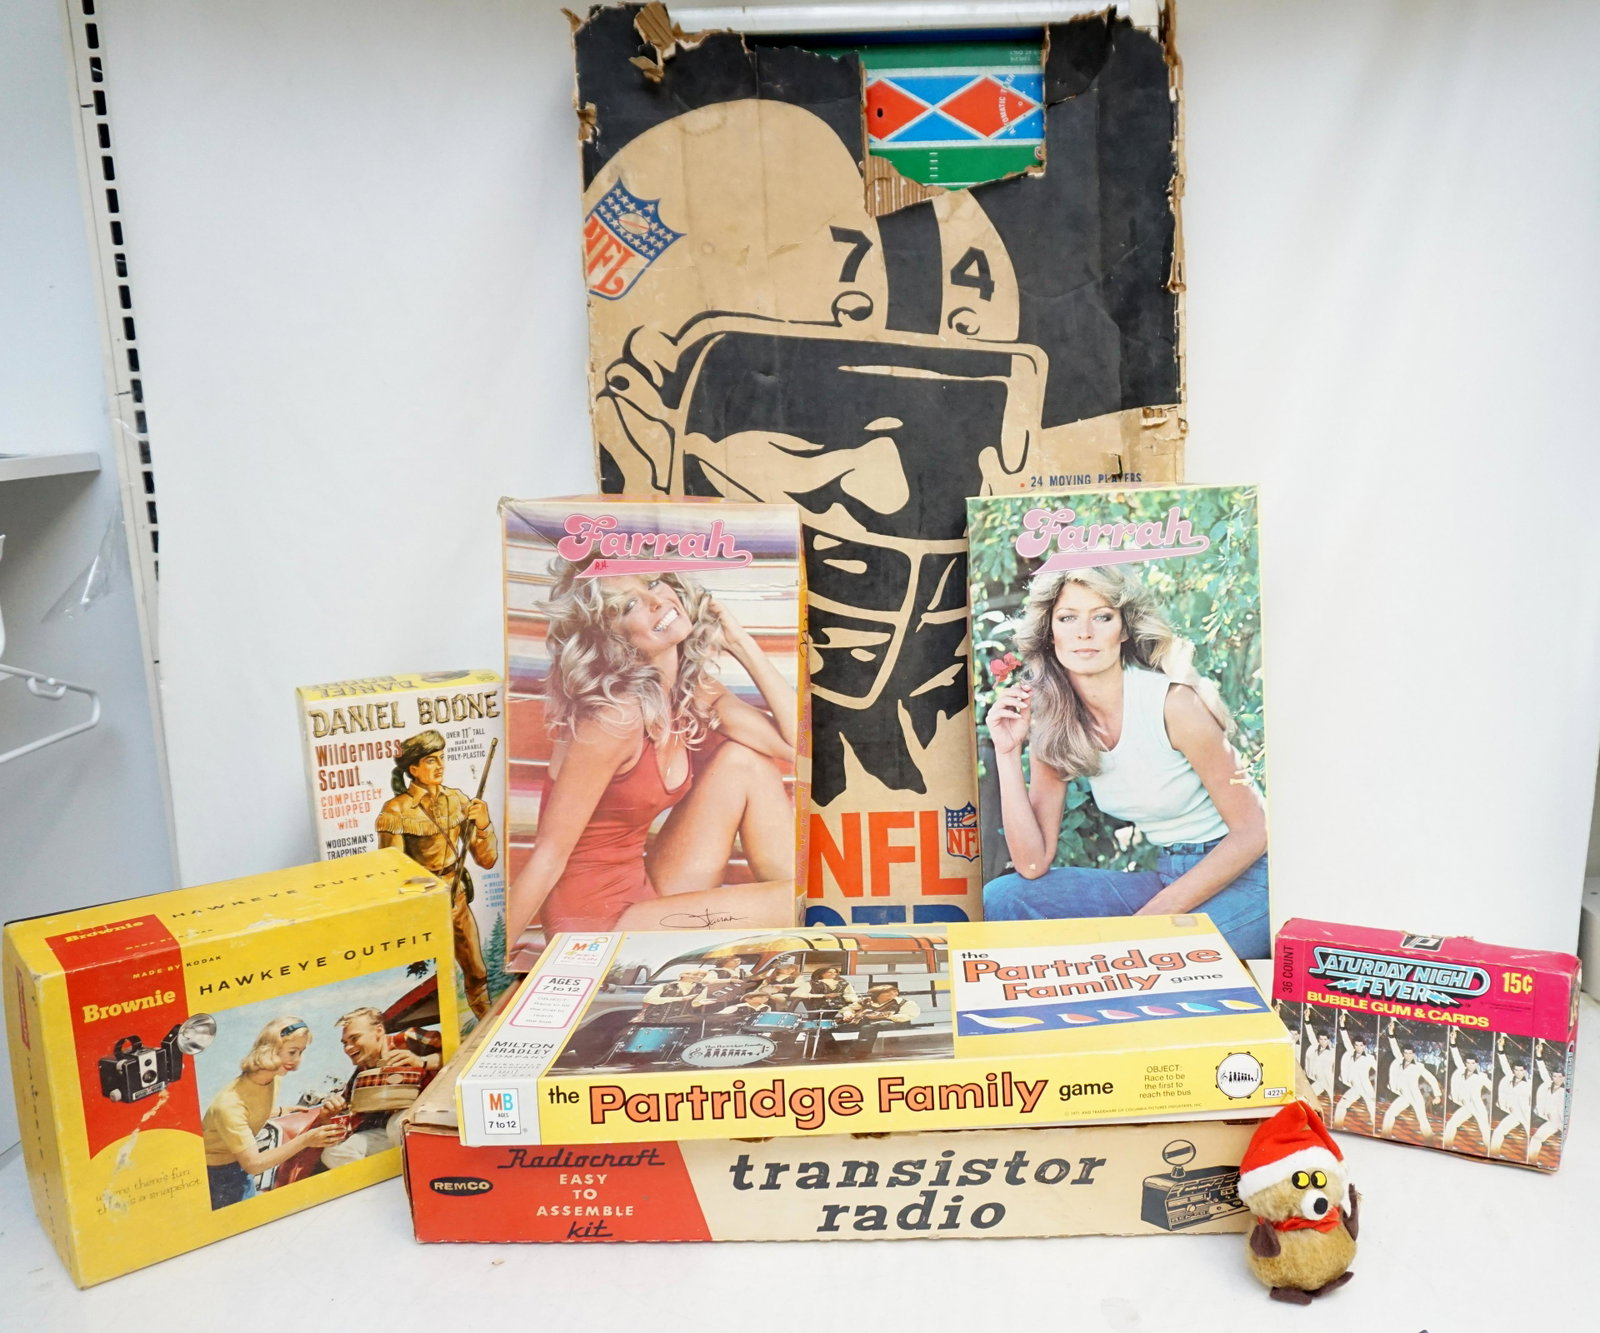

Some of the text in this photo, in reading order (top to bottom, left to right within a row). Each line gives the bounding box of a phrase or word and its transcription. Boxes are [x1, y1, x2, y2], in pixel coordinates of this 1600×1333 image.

[829, 225, 995, 302] 7 4
[1030, 476, 1043, 488] 24
[1049, 474, 1091, 487] MOVING
[557, 514, 752, 568] Farrah
[1015, 506, 1209, 566] Farrah
[308, 690, 500, 738] DANIEL BOONE
[446, 730, 460, 739] OVER
[473, 728, 485, 736] TALL
[315, 739, 403, 767] Wilderness
[447, 750, 485, 761] POLY-PLASTIC
[318, 765, 360, 792] Scout
[321, 788, 382, 807] COMPLETELY
[322, 801, 371, 819] EQUIPPED
[337, 818, 358, 830] with
[325, 833, 375, 849] WOODSMAN'S
[806, 810, 968, 899] NFL
[171, 867, 401, 919] HAWKEYE OUTFIT
[65, 920, 144, 943] Brownie
[199, 931, 433, 996] HAWKEYE OUTFIT
[962, 951, 988, 959] the
[132, 955, 222, 979] MADE BY KODAK
[962, 949, 1223, 983] Partridge
[1282, 945, 1294, 993] 36 COUNT
[1308, 946, 1480, 990] SATURDAY NIGHT
[548, 977, 581, 986] AGES
[1002, 972, 1223, 1001] Family game
[1355, 978, 1428, 1002] FEVER
[1502, 971, 1533, 995] 15¢
[82, 990, 176, 1024] Brownie
[1307, 991, 1490, 1028] BUBBLE GUM & CARDS
[489, 1047, 551, 1055] BRADLEY
[494, 1041, 555, 1049] MILTON
[1144, 1074, 1164, 1082] Race
[1146, 1064, 1182, 1073] OBJECT:
[489, 1093, 514, 1111] MB
[548, 1071, 1114, 1130] the Partridge Family game
[1139, 1091, 1161, 1099] reach
[488, 1121, 494, 1129] 7
[507, 1121, 517, 1129] 12
[497, 1148, 665, 1169] Radiocraft
[171, 1167, 190, 1179] fun
[559, 1173, 608, 1186] EASY
[728, 1149, 1107, 1191] transistor
[433, 1180, 491, 1191] REMCO
[572, 1188, 597, 1200] TO
[536, 1204, 634, 1217] ASSEMBLE
[816, 1189, 1006, 1233] radio
[566, 1220, 613, 1239] kit
